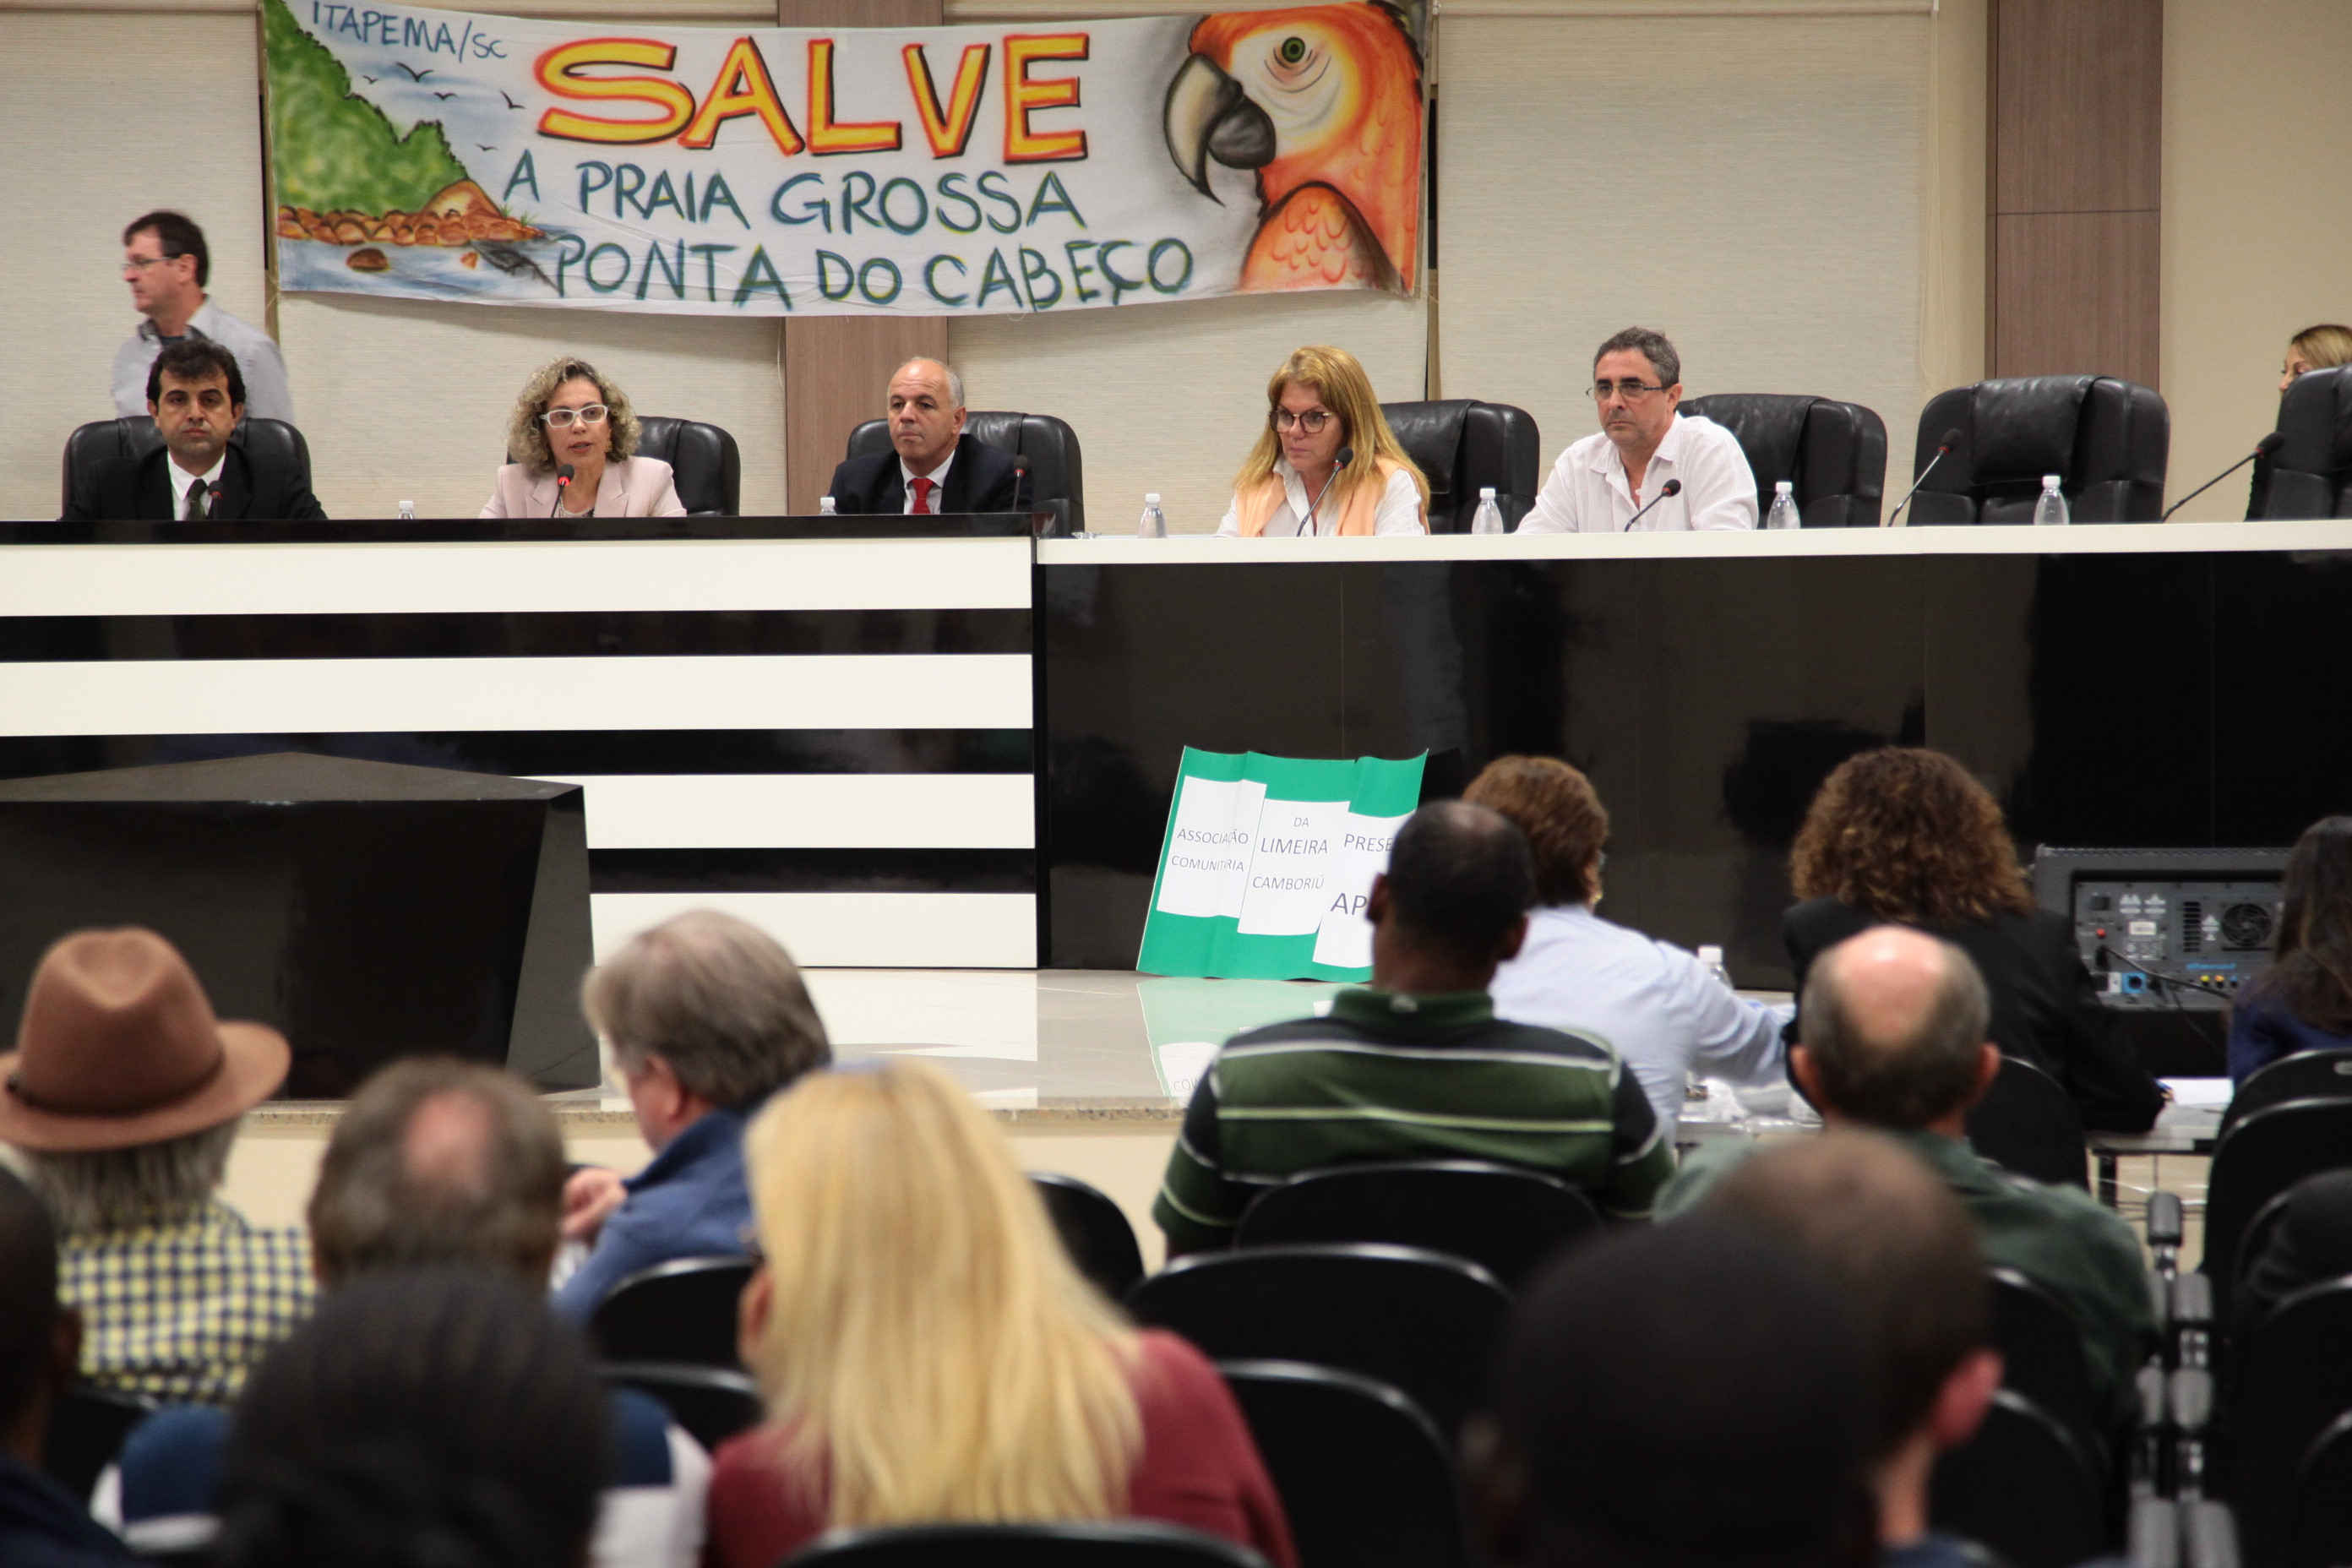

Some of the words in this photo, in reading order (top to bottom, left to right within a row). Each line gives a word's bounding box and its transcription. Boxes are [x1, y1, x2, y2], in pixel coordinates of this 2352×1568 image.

[313, 1, 509, 63] ITAPEMA/SC
[534, 34, 1090, 163] SALVE
[504, 149, 540, 203] A
[576, 161, 751, 230] PRAIA
[770, 171, 1088, 235] GROSSA
[558, 233, 792, 310] PONTA
[817, 249, 902, 303] DO
[923, 237, 1195, 313] CABEÇO
[1293, 817, 1309, 827] DA
[1260, 837, 1328, 854] LIMEIRA
[1343, 833, 1394, 852] PRESE
[1252, 874, 1325, 890] CAMBORIÚ
[1330, 892, 1368, 916] AP
